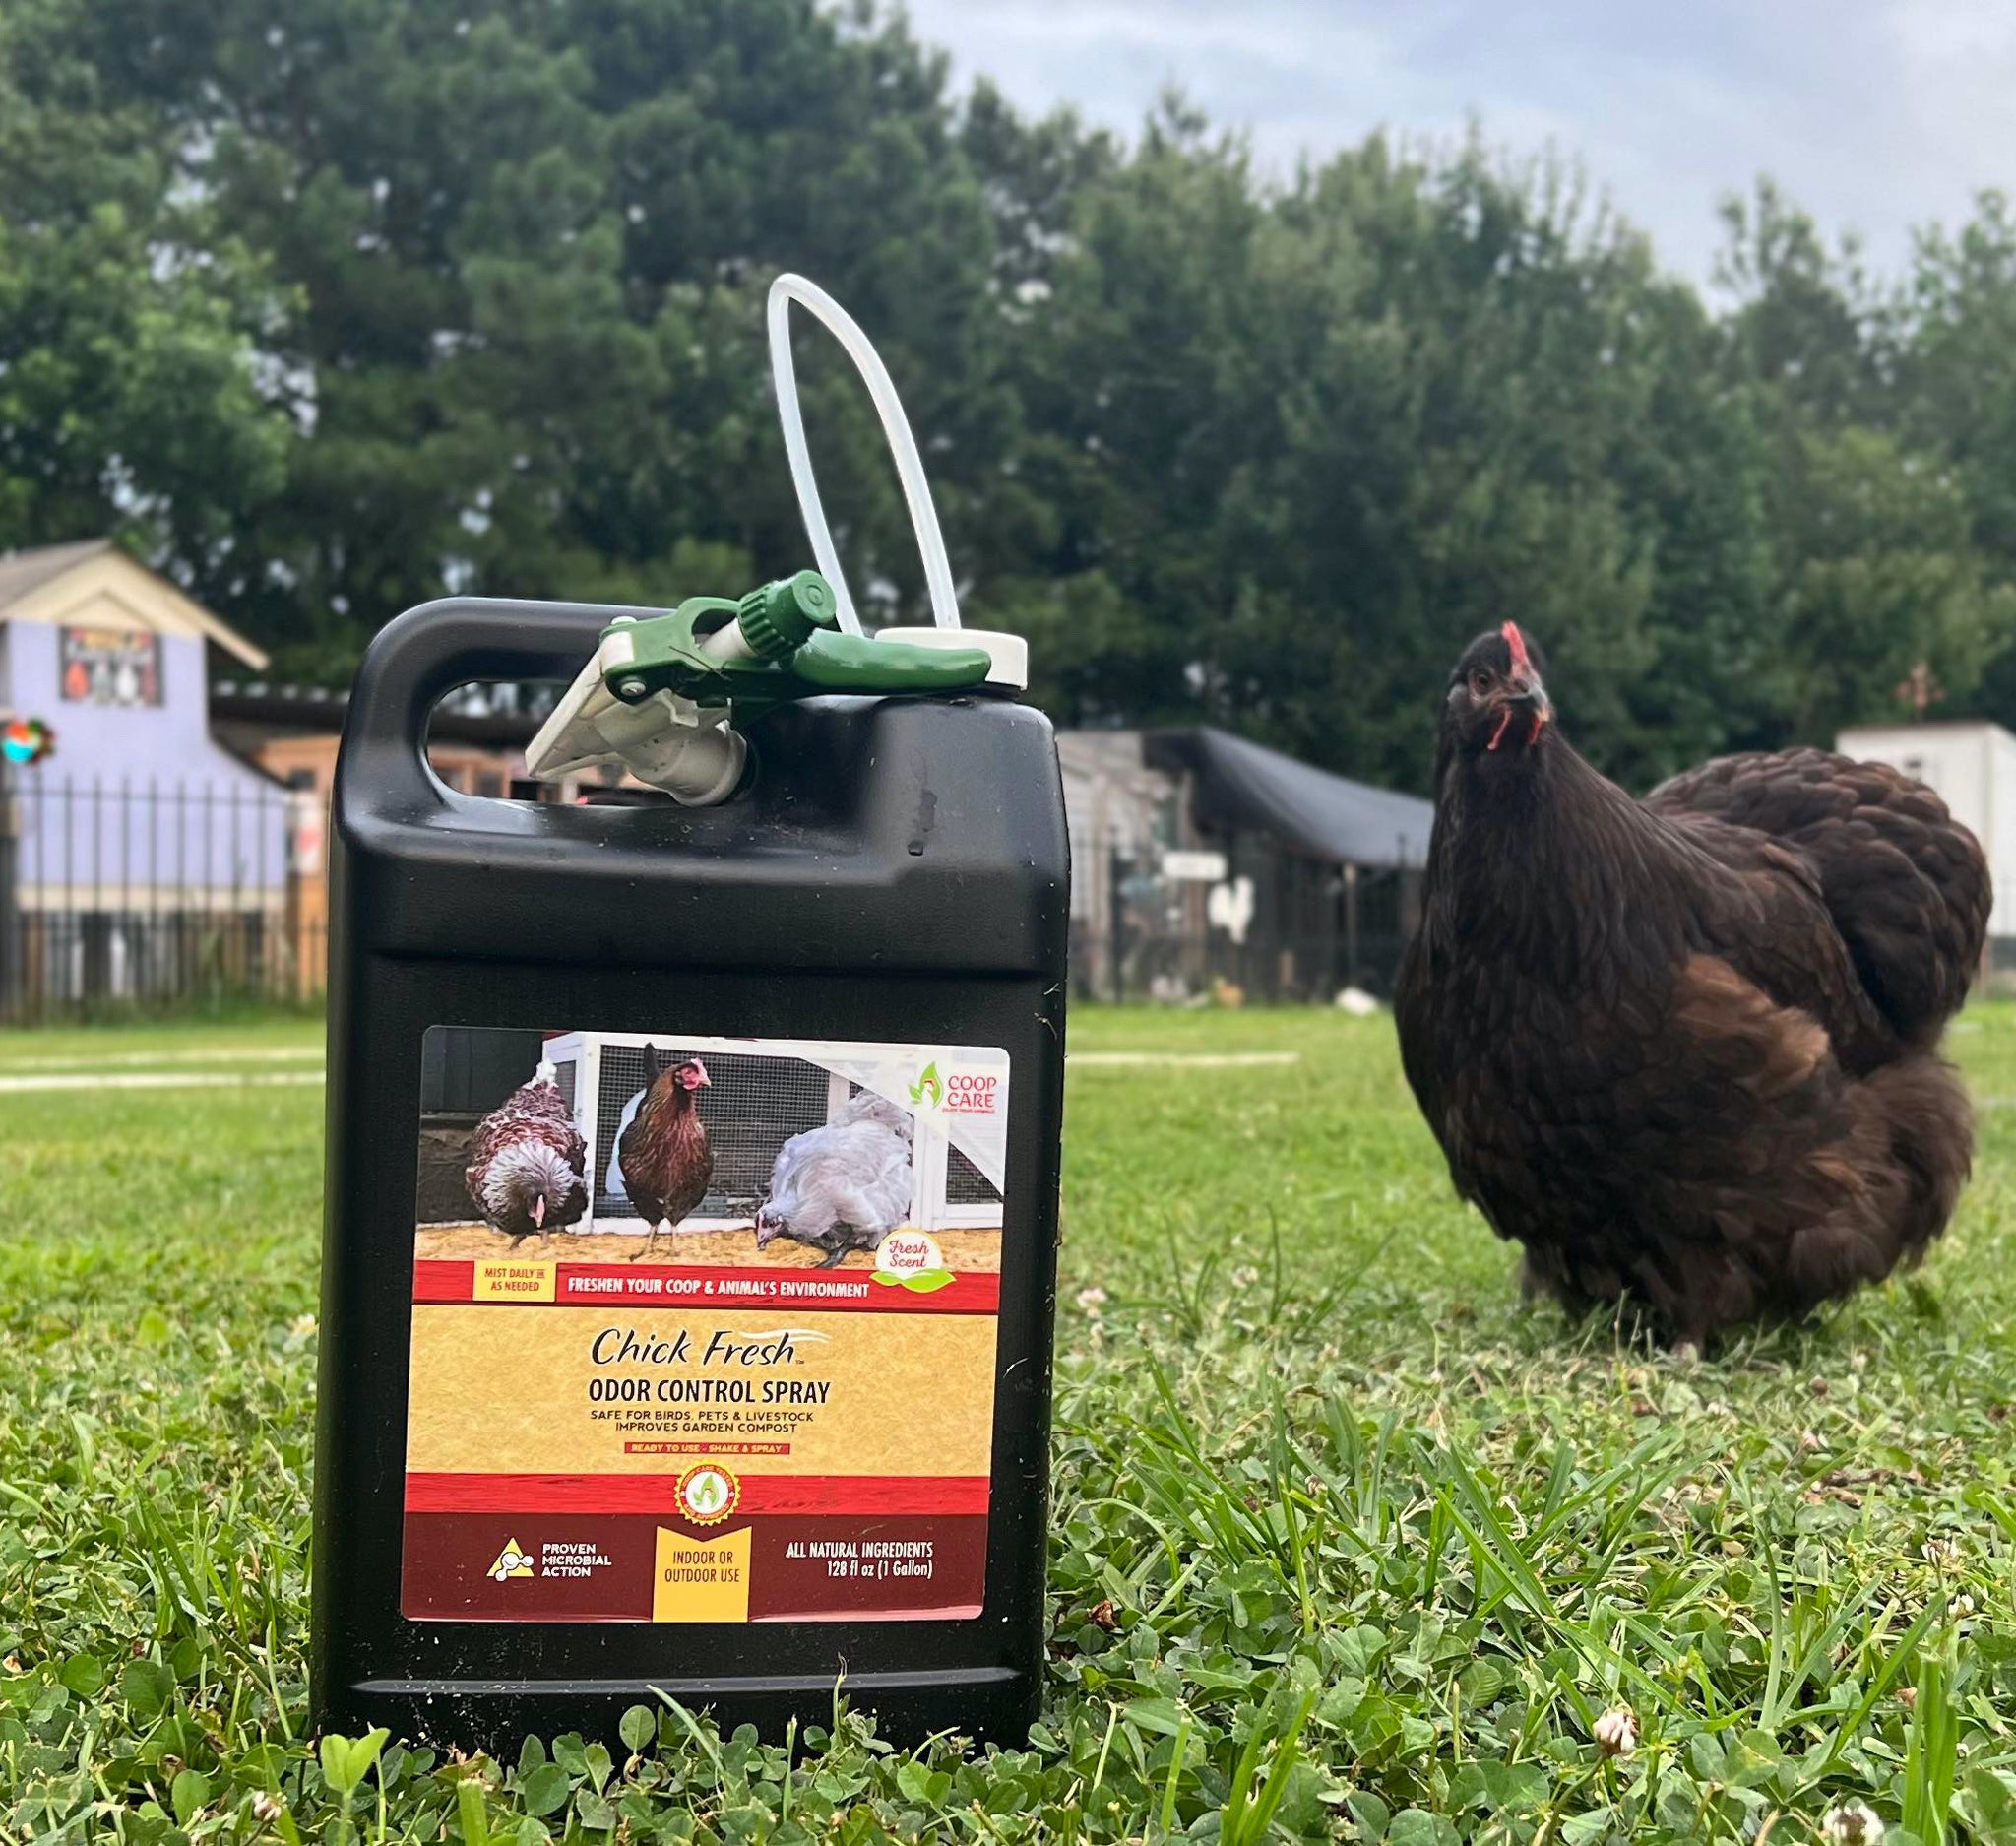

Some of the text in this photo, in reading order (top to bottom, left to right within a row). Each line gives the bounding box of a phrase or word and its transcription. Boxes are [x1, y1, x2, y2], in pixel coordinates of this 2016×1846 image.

[948, 1075, 997, 1092] COOP
[947, 1092, 995, 1108] CARE
[889, 1240, 929, 1254] Fresh
[889, 1253, 926, 1268] Scent
[484, 1267, 507, 1278] MIST
[509, 1268, 535, 1279] DAILY
[490, 1281, 539, 1292] AS NEEDED
[567, 1277, 870, 1298] FRESHEN YOUR COOP & ANIMAL'S ENVIRONMENT
[592, 1328, 691, 1365] Chick
[703, 1329, 794, 1366] Fresh
[589, 1378, 831, 1404] ODOR CONTROL SPRAY
[591, 1410, 622, 1420] SAFE
[626, 1410, 651, 1420] FOR
[698, 1411, 729, 1421] PETS
[733, 1412, 741, 1421] &
[745, 1412, 814, 1422] LIVESTOCK
[615, 1422, 798, 1432] IMPROVES GARDEN COMPOST
[631, 1443, 663, 1452] READY
[751, 1444, 783, 1453] SPRAY
[541, 1543, 597, 1555] PROVEN
[785, 1541, 934, 1559] ALL NATURAL INGREDIENTS
[541, 1555, 612, 1566] MICROBIAL
[672, 1551, 733, 1565] INDOOR OR
[541, 1566, 592, 1577] ACTION
[664, 1568, 740, 1583] OUTDOOR USE
[827, 1560, 933, 1580] 128 fl oz (1 Gallon)
